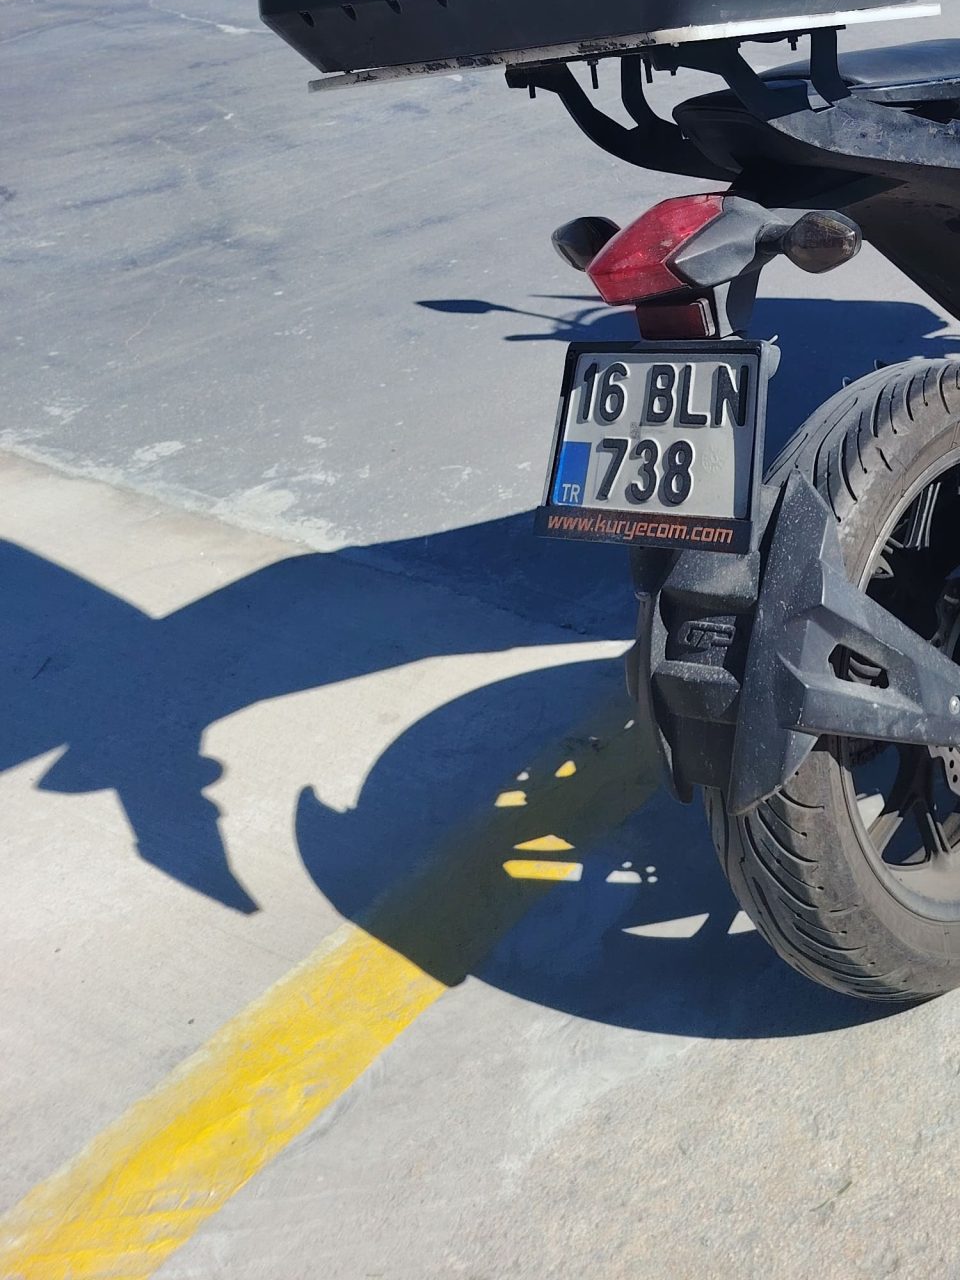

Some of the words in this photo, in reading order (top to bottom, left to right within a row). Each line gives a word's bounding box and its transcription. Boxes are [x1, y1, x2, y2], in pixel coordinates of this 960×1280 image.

[580, 362, 630, 423] 16
[645, 363, 750, 427] BLN
[562, 483, 581, 503] TR
[594, 438, 694, 505] 738
[547, 514, 734, 545] www.kuryecom.com
